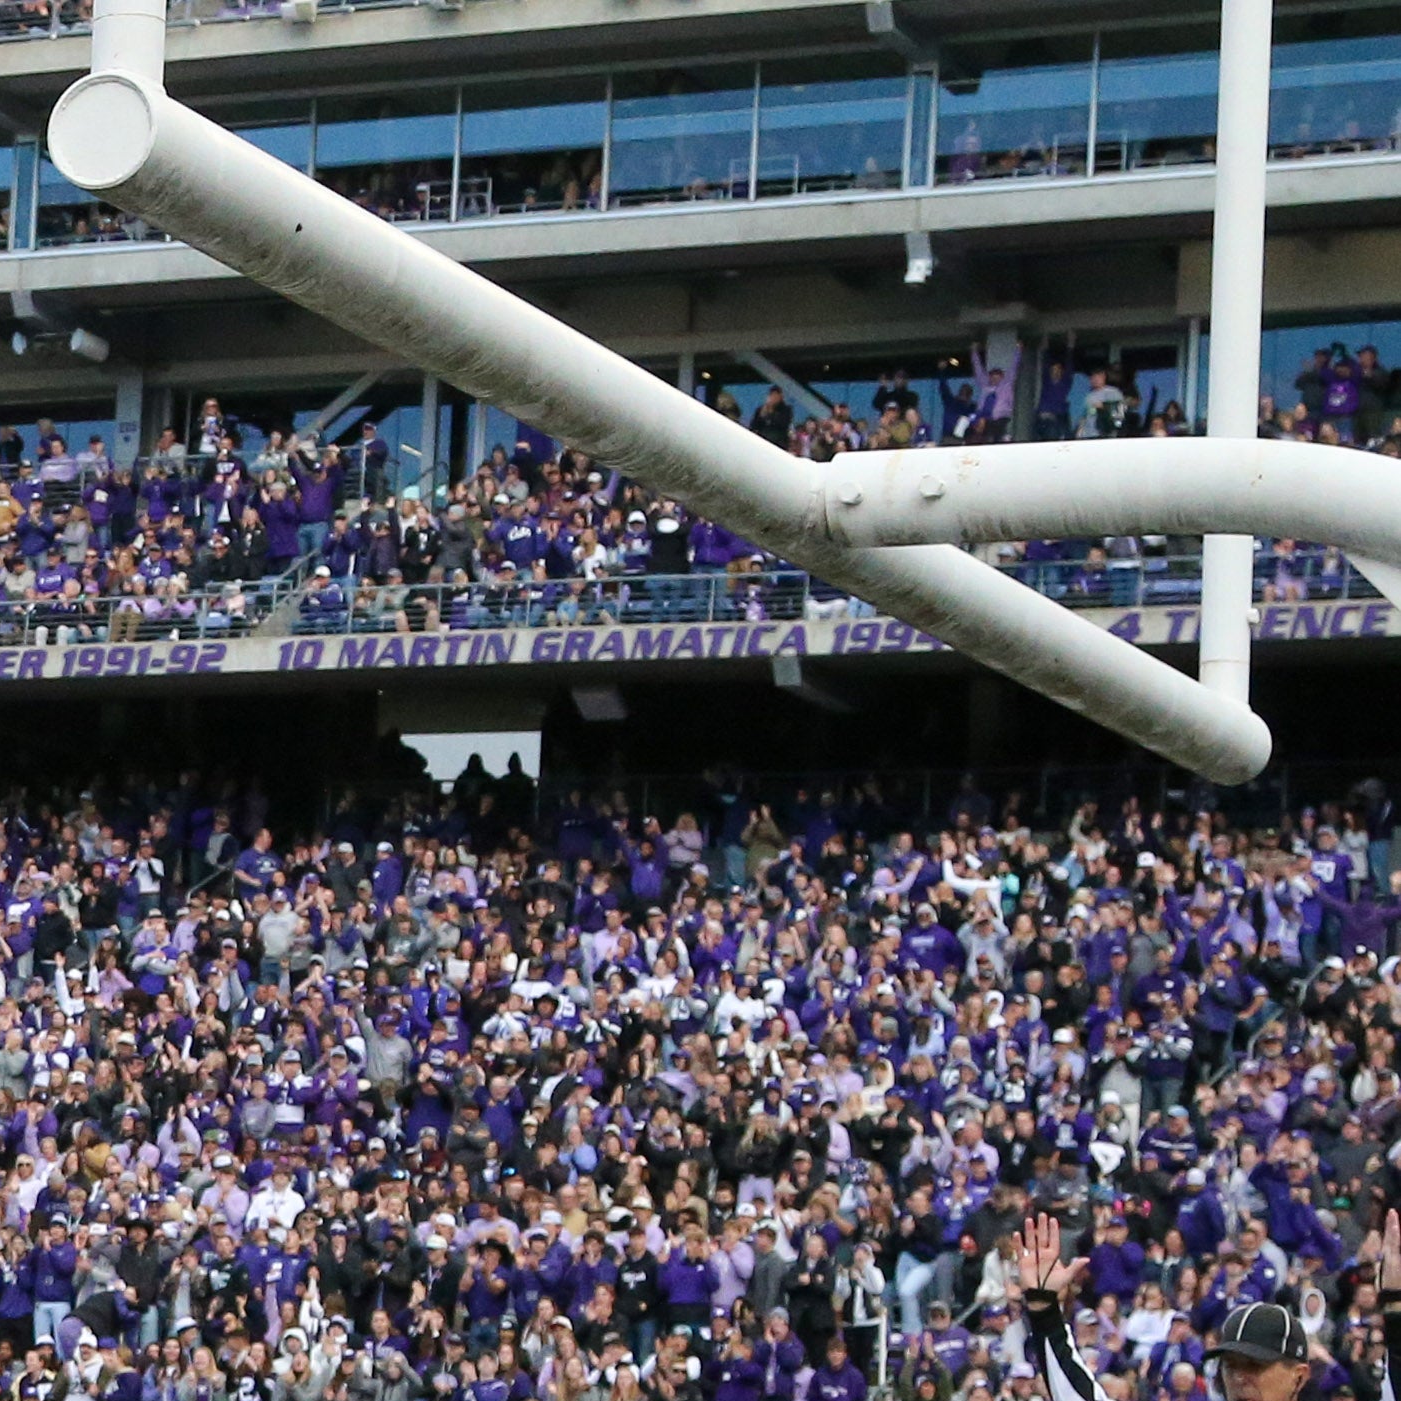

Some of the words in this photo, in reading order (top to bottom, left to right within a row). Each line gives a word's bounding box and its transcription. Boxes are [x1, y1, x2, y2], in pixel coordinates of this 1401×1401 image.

[1166, 603, 1396, 642] TENCE
[61, 642, 228, 677] 1991-92
[277, 638, 325, 671] 10
[337, 632, 517, 669] MARTIN
[530, 623, 808, 664] GRAMATICA
